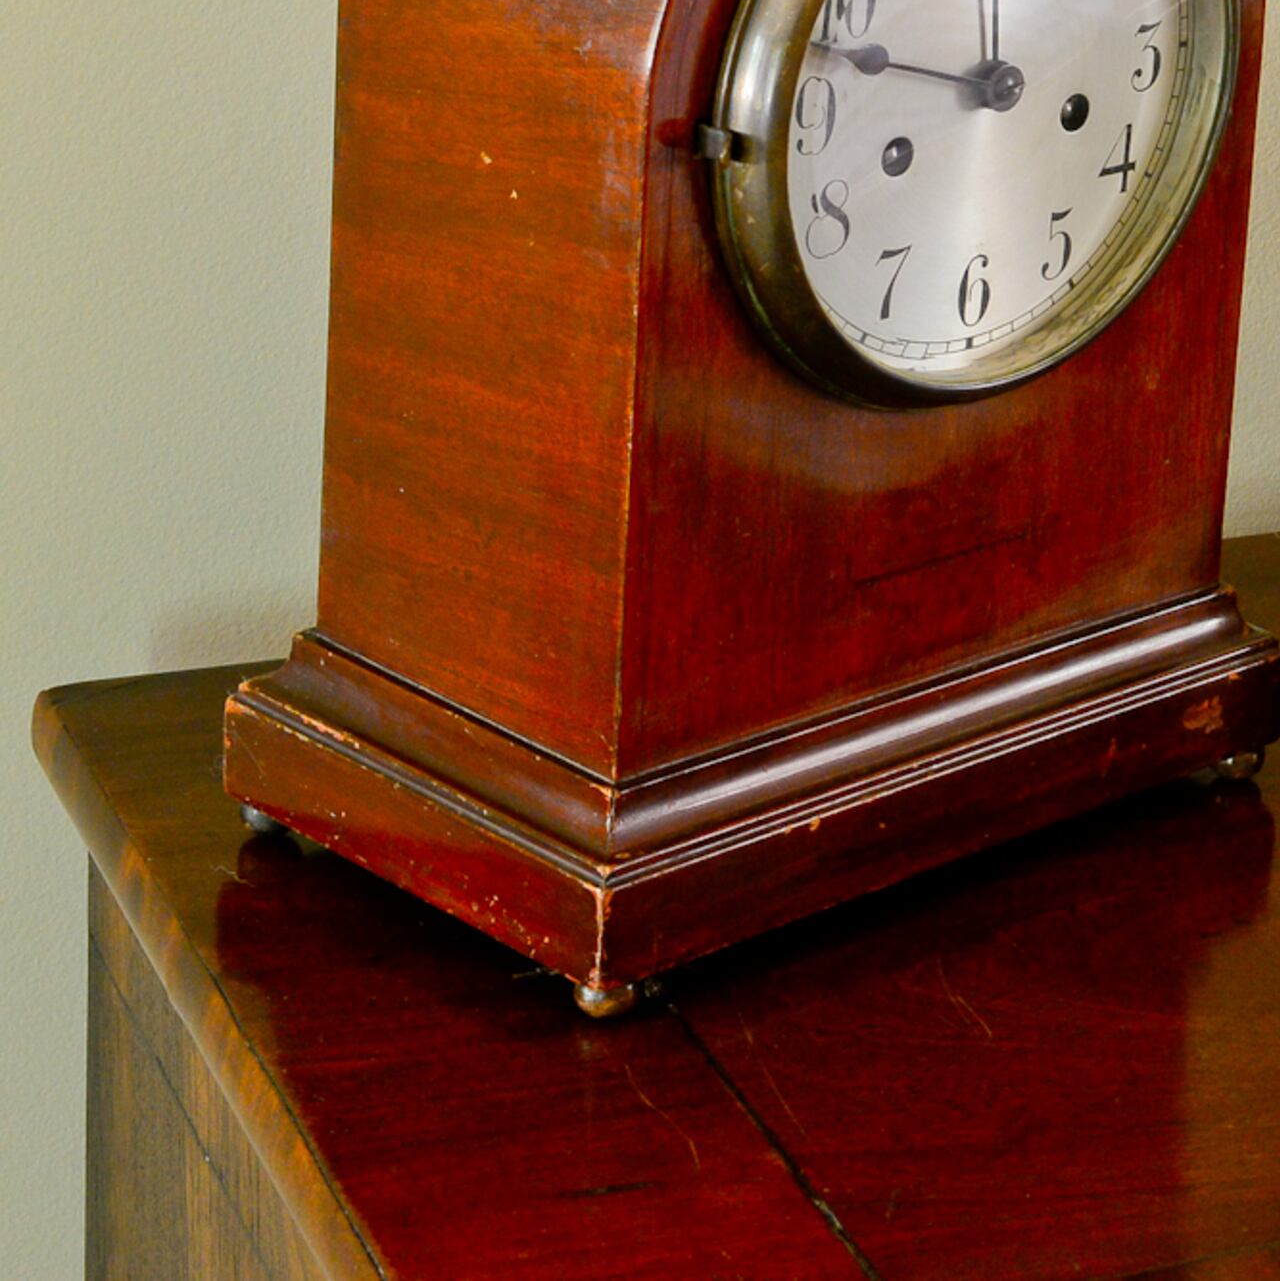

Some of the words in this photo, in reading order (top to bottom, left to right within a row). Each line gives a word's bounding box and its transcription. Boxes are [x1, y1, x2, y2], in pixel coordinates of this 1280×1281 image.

[1129, 20, 1162, 93] 3
[794, 75, 837, 156] 9
[1098, 122, 1136, 193] 4
[805, 178, 850, 259] 8
[1041, 206, 1074, 280] 5
[875, 244, 913, 320] 7
[957, 254, 991, 327] 6
